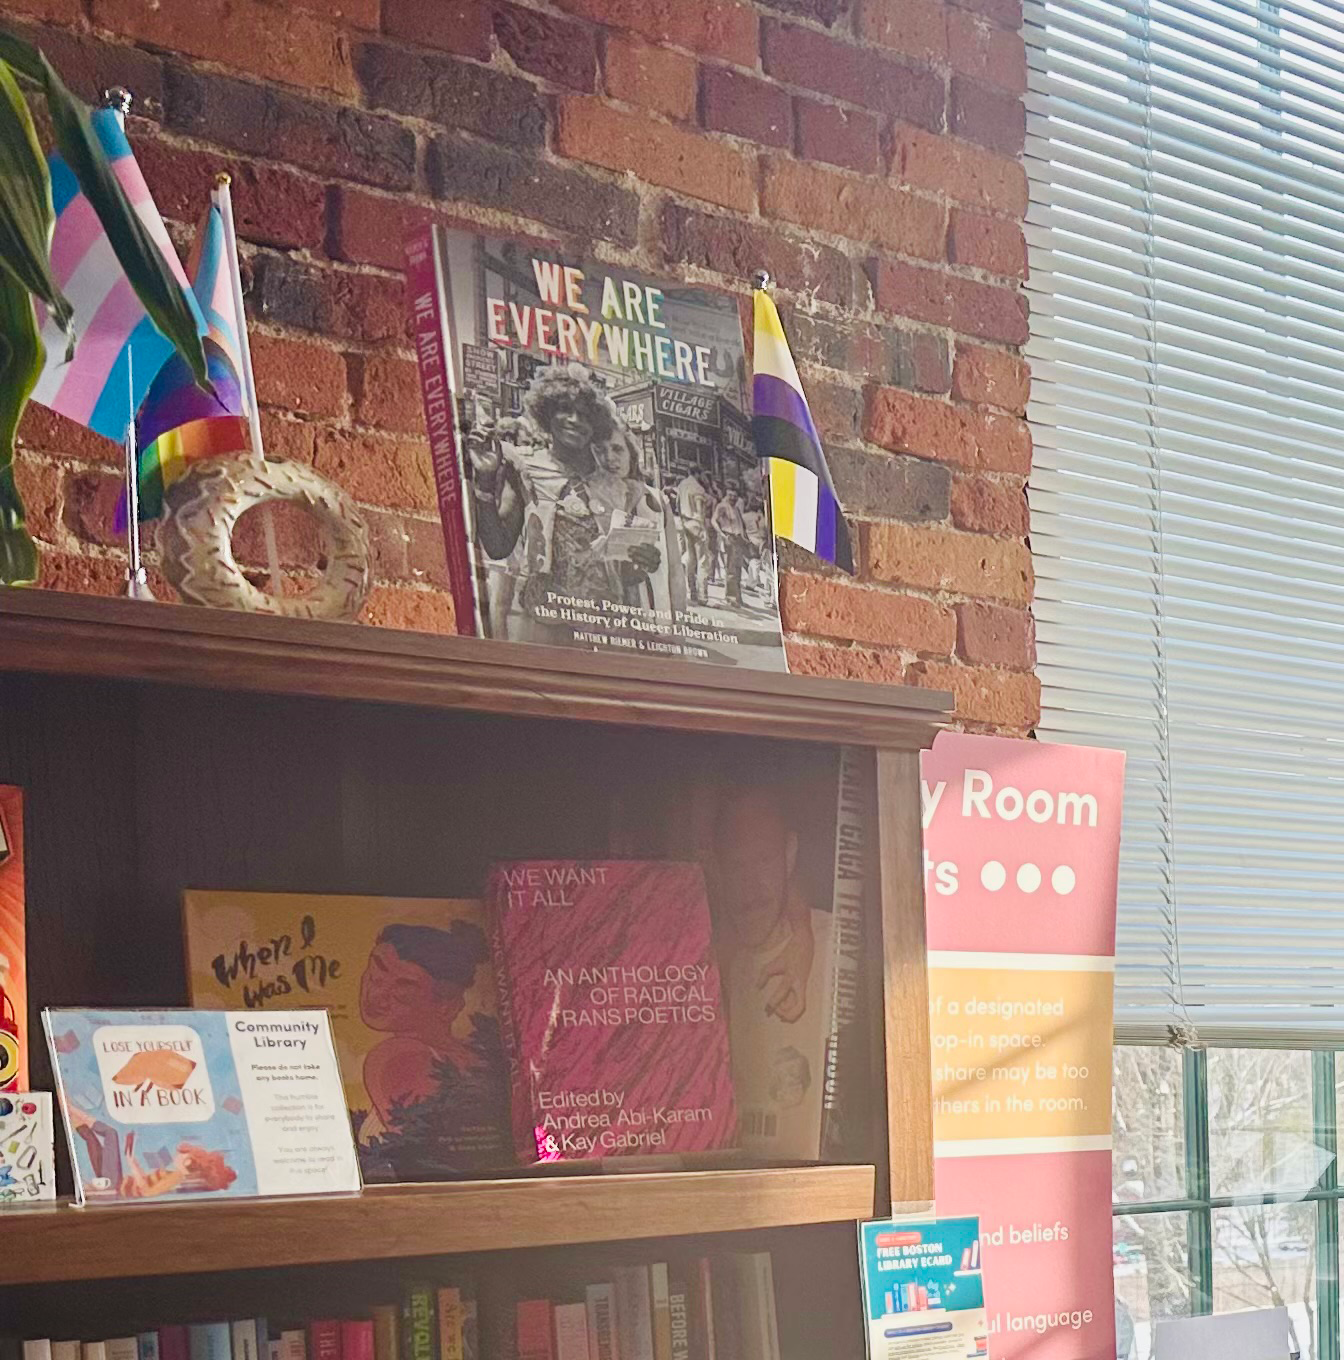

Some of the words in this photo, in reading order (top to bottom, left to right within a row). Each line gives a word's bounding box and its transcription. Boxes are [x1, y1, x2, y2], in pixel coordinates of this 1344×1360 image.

[531, 258, 589, 315] WE
[601, 275, 666, 330] ARE
[414, 291, 434, 325] WE
[419, 331, 440, 369] ARE
[486, 297, 716, 388] EVERYWHERE
[659, 387, 713, 410] VILLAGE
[661, 400, 710, 422] CIGARS
[424, 373, 456, 507] EVERYWHERE
[546, 591, 600, 612] Protest,
[675, 610, 709, 626] Pride
[535, 605, 558, 619] the
[560, 608, 611, 629] History
[630, 618, 671, 636] Queer
[673, 623, 739, 644] Liberation
[961, 769, 1099, 828] Room
[503, 868, 542, 887] WE
[544, 867, 608, 885] WANT
[507, 891, 524, 909] IT
[533, 890, 574, 908] ALL
[211, 934, 292, 989] When
[291, 954, 341, 994] Me
[543, 968, 574, 986] AN
[577, 964, 710, 985] ANTHOLOGY
[590, 987, 619, 1005] OF
[624, 985, 713, 1003] RADICAL
[547, 1008, 621, 1027] TRANS
[626, 1004, 716, 1024] POETICS
[964, 995, 1064, 1020] designated
[234, 1021, 319, 1036] Community
[102, 1041, 132, 1053] LOSE
[253, 1036, 307, 1051] Library
[934, 1029, 985, 1051] op-in
[989, 1033, 1047, 1053] space.
[934, 1063, 987, 1082] share
[991, 1065, 1030, 1087] may
[1034, 1062, 1057, 1081] be
[1062, 1063, 1089, 1080] too
[112, 1090, 133, 1109] IN
[156, 1088, 207, 1107] BOOK
[538, 1090, 600, 1110] Edited
[602, 1089, 625, 1110] by
[933, 1094, 980, 1114] thers
[984, 1094, 1001, 1113] in
[1005, 1094, 1034, 1113] the
[1038, 1095, 1089, 1113] room.
[543, 1109, 611, 1130] Andrea
[616, 1107, 713, 1127] Abi-Karam
[545, 1135, 560, 1152] &
[562, 1133, 597, 1153] Kay
[600, 1128, 667, 1148] Gabriel
[1009, 1222, 1070, 1244] beliefs
[876, 1246, 900, 1258] FREE
[902, 1242, 943, 1256] BOSTON
[877, 1258, 918, 1272] LIBRARY
[920, 1254, 953, 1268] ECARD
[670, 1293, 688, 1348] BEFORE
[1006, 1308, 1094, 1337] language
[319, 1331, 338, 1358] THE
